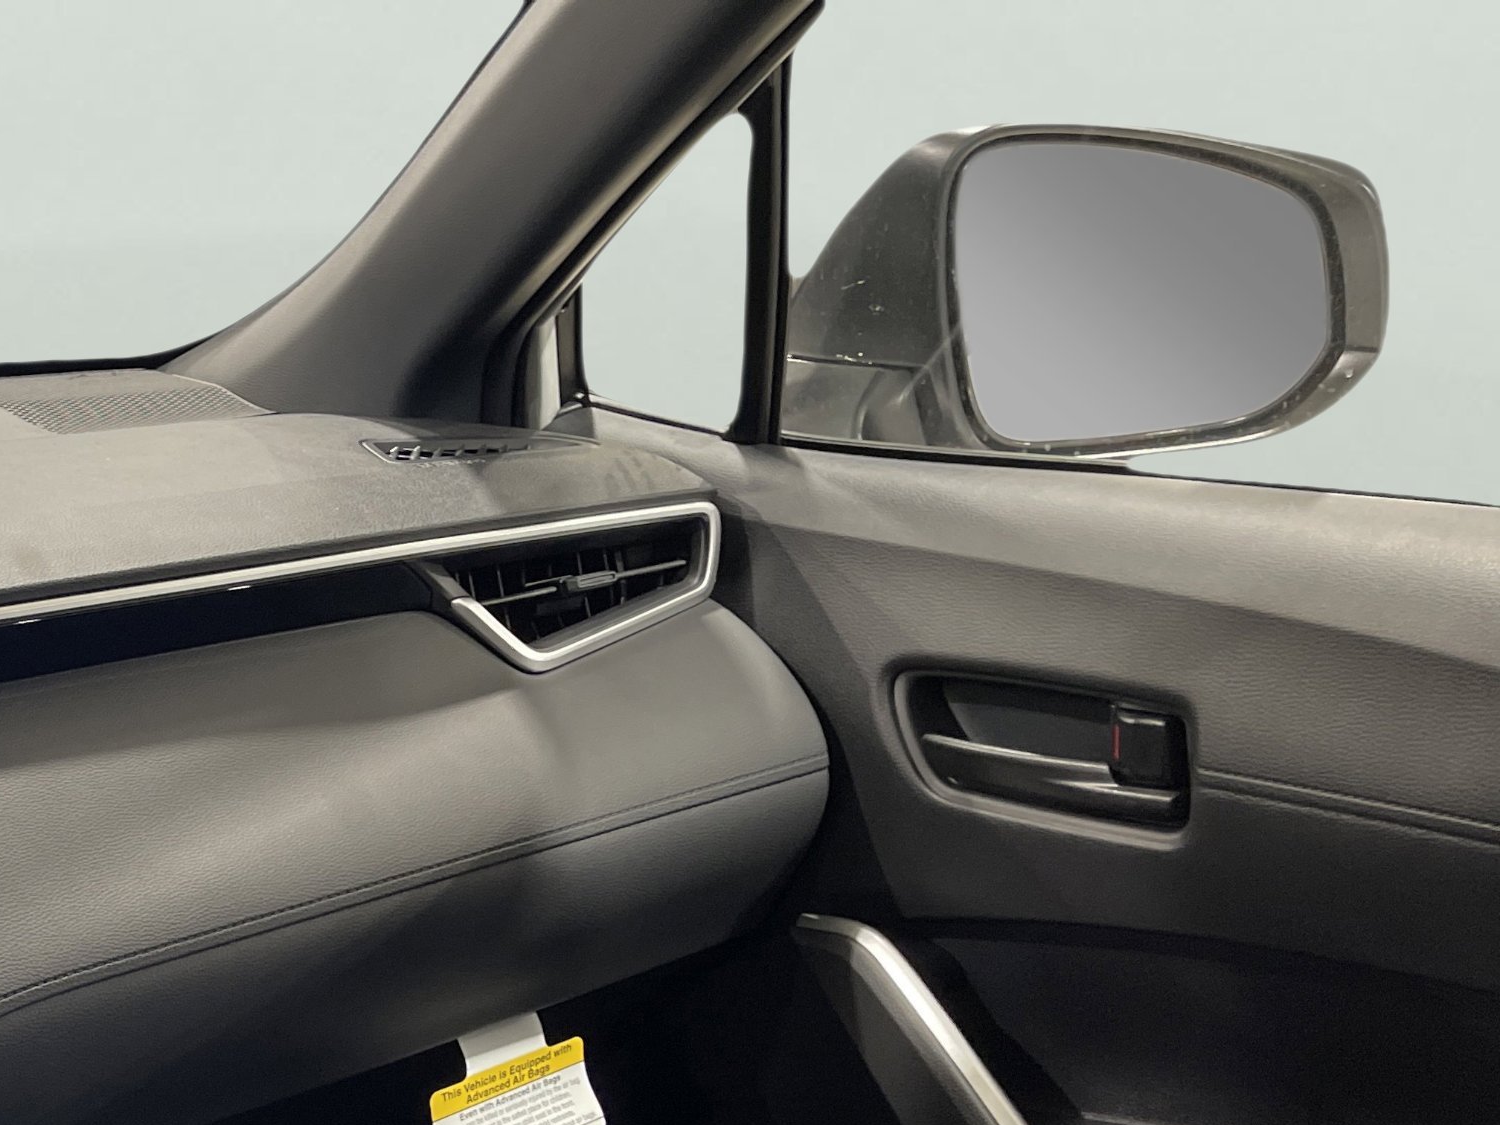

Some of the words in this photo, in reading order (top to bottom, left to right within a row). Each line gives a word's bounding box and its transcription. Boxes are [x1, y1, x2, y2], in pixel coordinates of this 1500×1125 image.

[440, 1087, 460, 1101] This
[463, 1073, 496, 1092] Vehicle
[499, 1069, 506, 1078] is
[509, 1050, 550, 1075] Equipped
[553, 1044, 571, 1056] with
[466, 1078, 510, 1104] Advanced
[513, 1073, 524, 1084] Air
[529, 1064, 549, 1078] Bags
[496, 1086, 529, 1106] Advanced
[532, 1082, 540, 1091] Air
[542, 1074, 560, 1086] Bags
